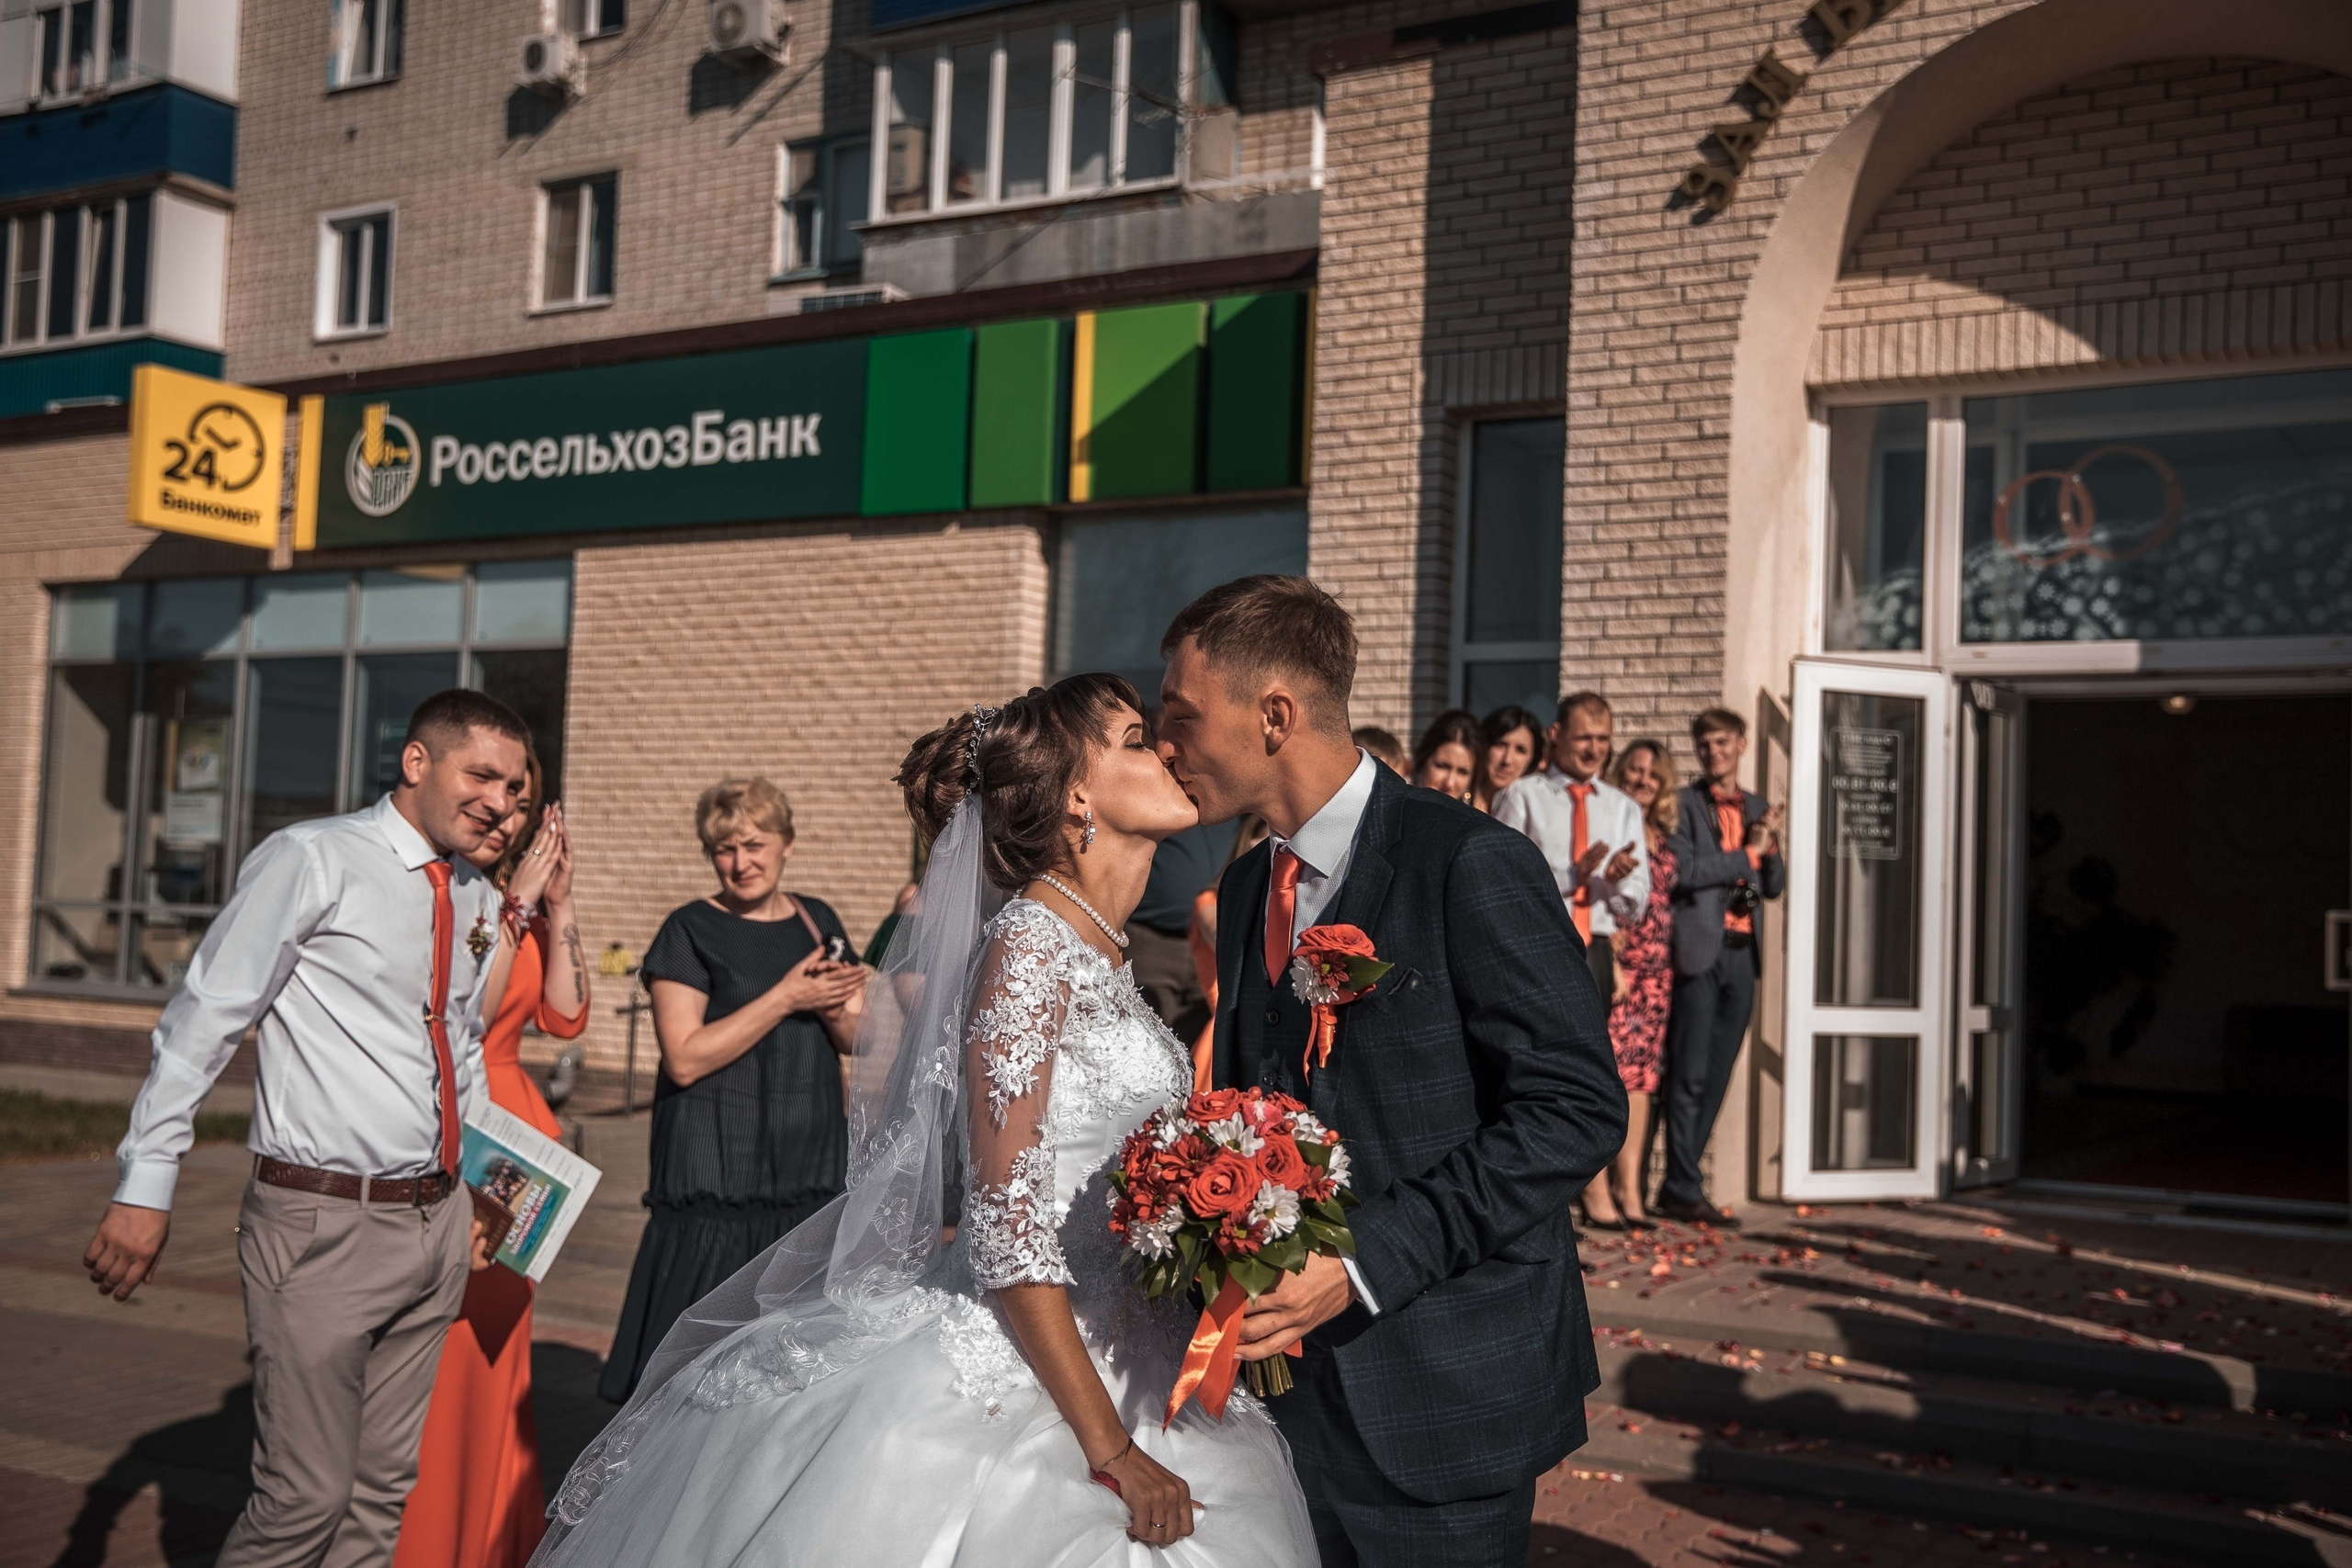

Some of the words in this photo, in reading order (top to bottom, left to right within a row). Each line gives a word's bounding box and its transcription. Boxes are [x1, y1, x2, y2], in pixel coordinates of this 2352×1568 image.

[1685, 49, 1809, 214] ЗАЛ
[164, 441, 219, 488] 24
[429, 410, 821, 487] РоссельхозБанк
[161, 491, 261, 525] Банкомат
[503, 1182, 542, 1246] ОСНОВЫ
